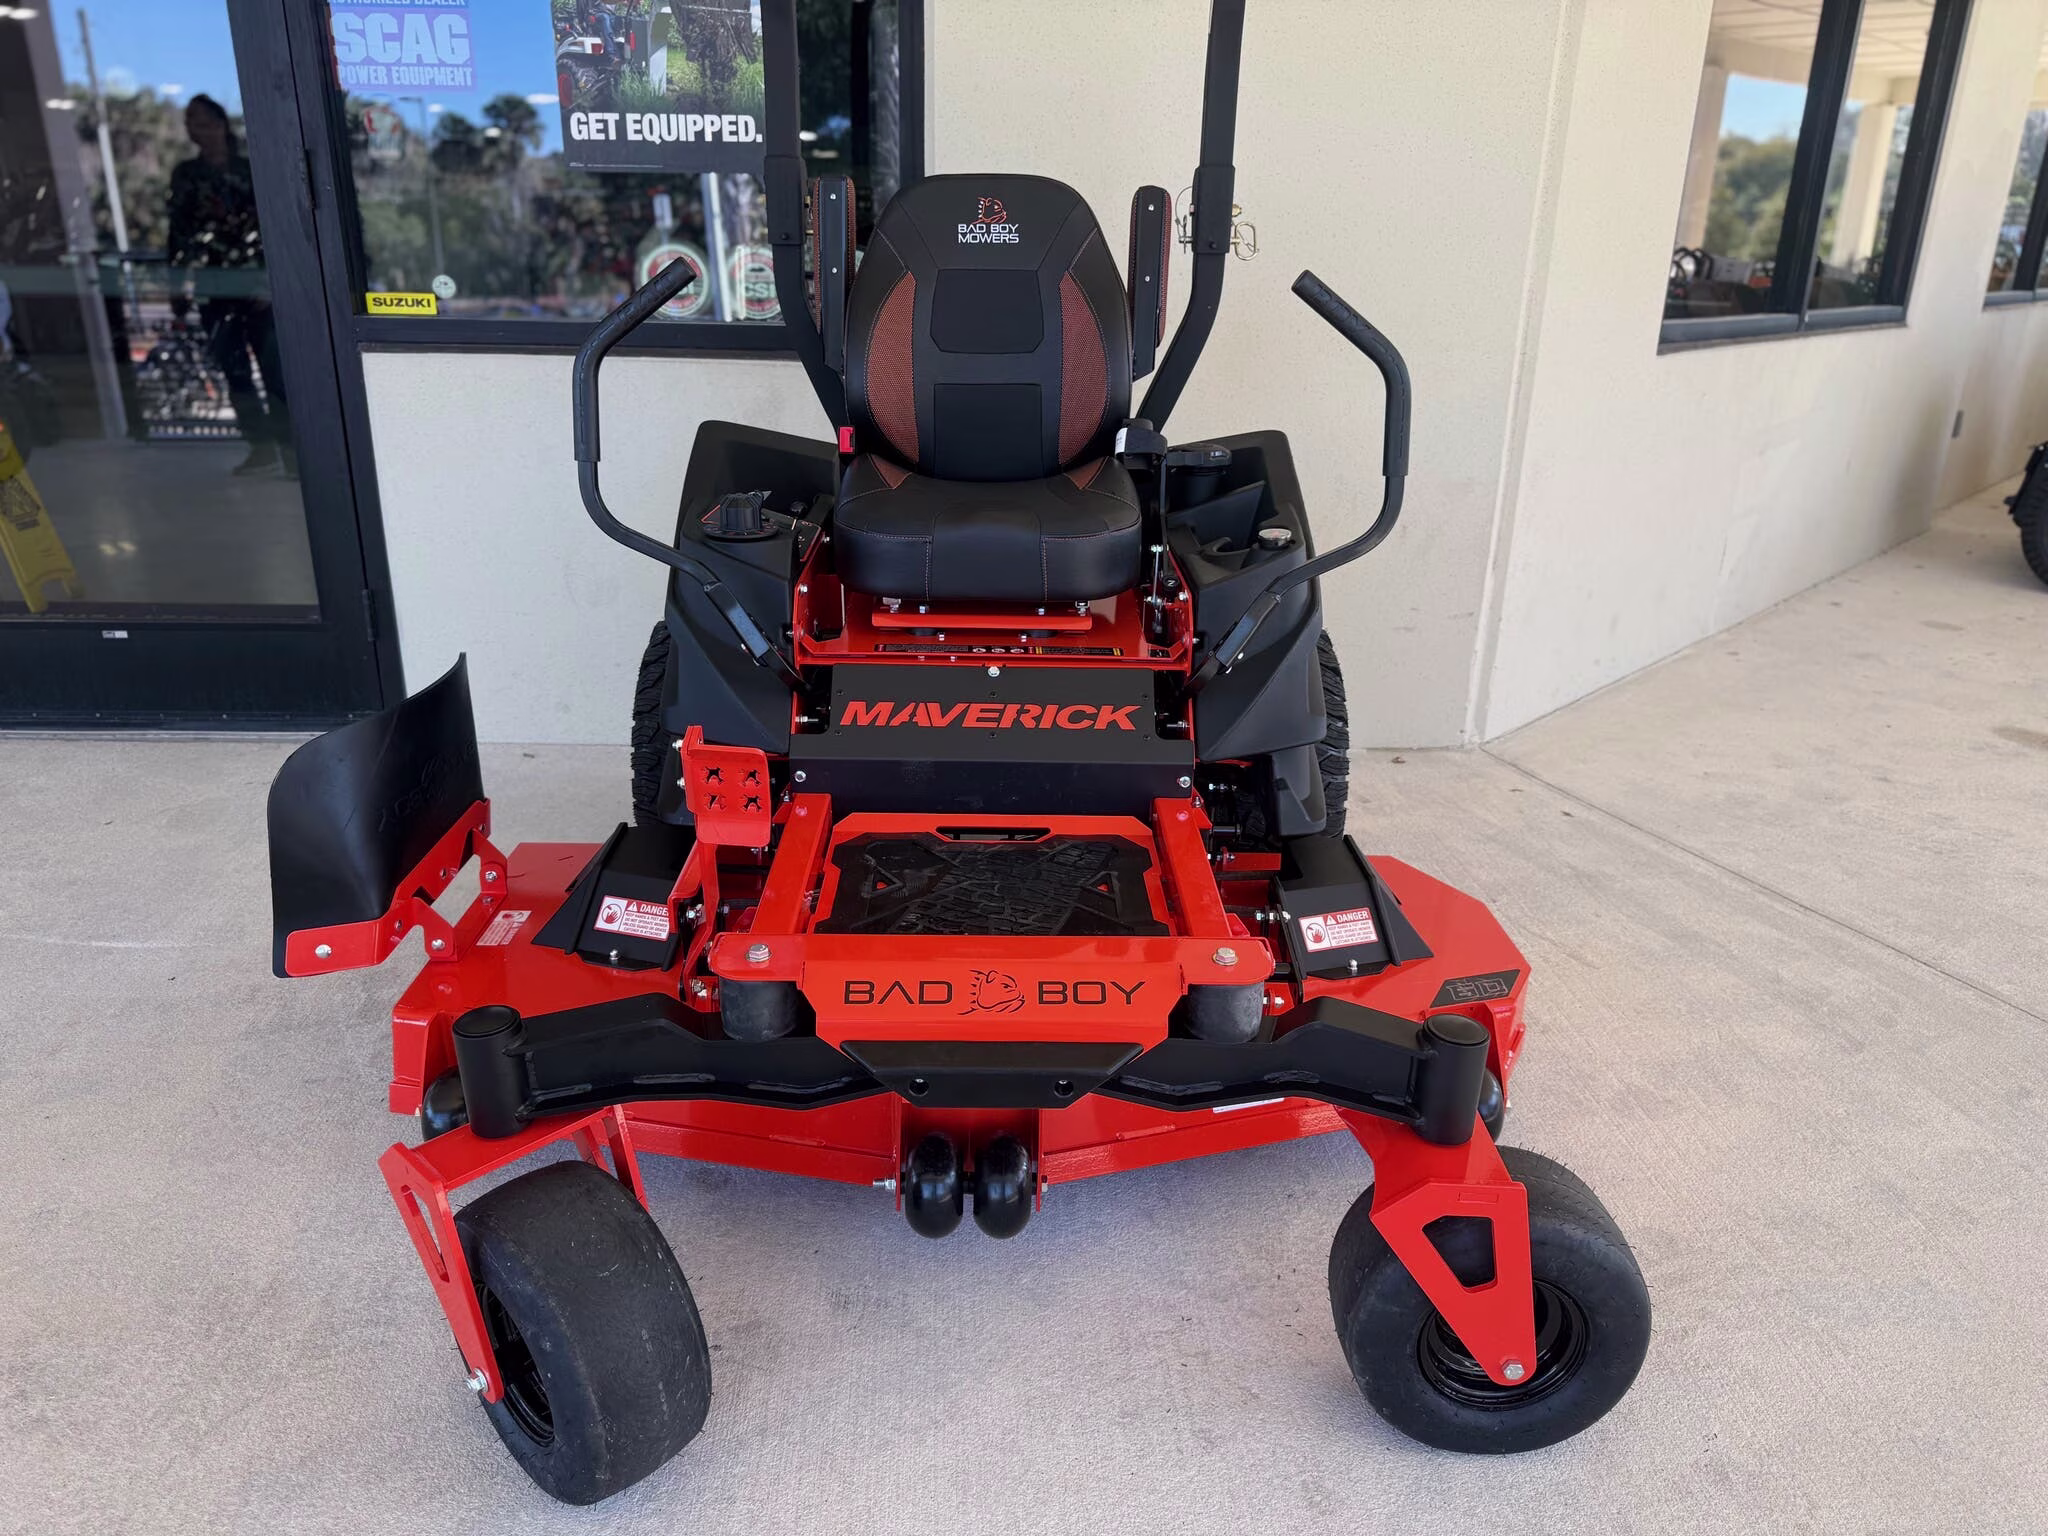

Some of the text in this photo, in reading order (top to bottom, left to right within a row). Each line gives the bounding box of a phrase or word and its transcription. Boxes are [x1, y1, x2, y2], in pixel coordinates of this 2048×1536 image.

[331, 12, 471, 64] SCAG
[391, 66, 473, 86] EQUIPMENT
[569, 112, 763, 145] GET EQUIPPED.
[957, 223, 1019, 234] BAD BOY
[957, 233, 1020, 244] MOWERS
[372, 297, 431, 308] SUZUKI
[839, 701, 1142, 731] MAVERICK
[640, 904, 669, 916] DANGE
[1336, 911, 1369, 923] DANGER
[843, 980, 1147, 1006] BAD BOY
